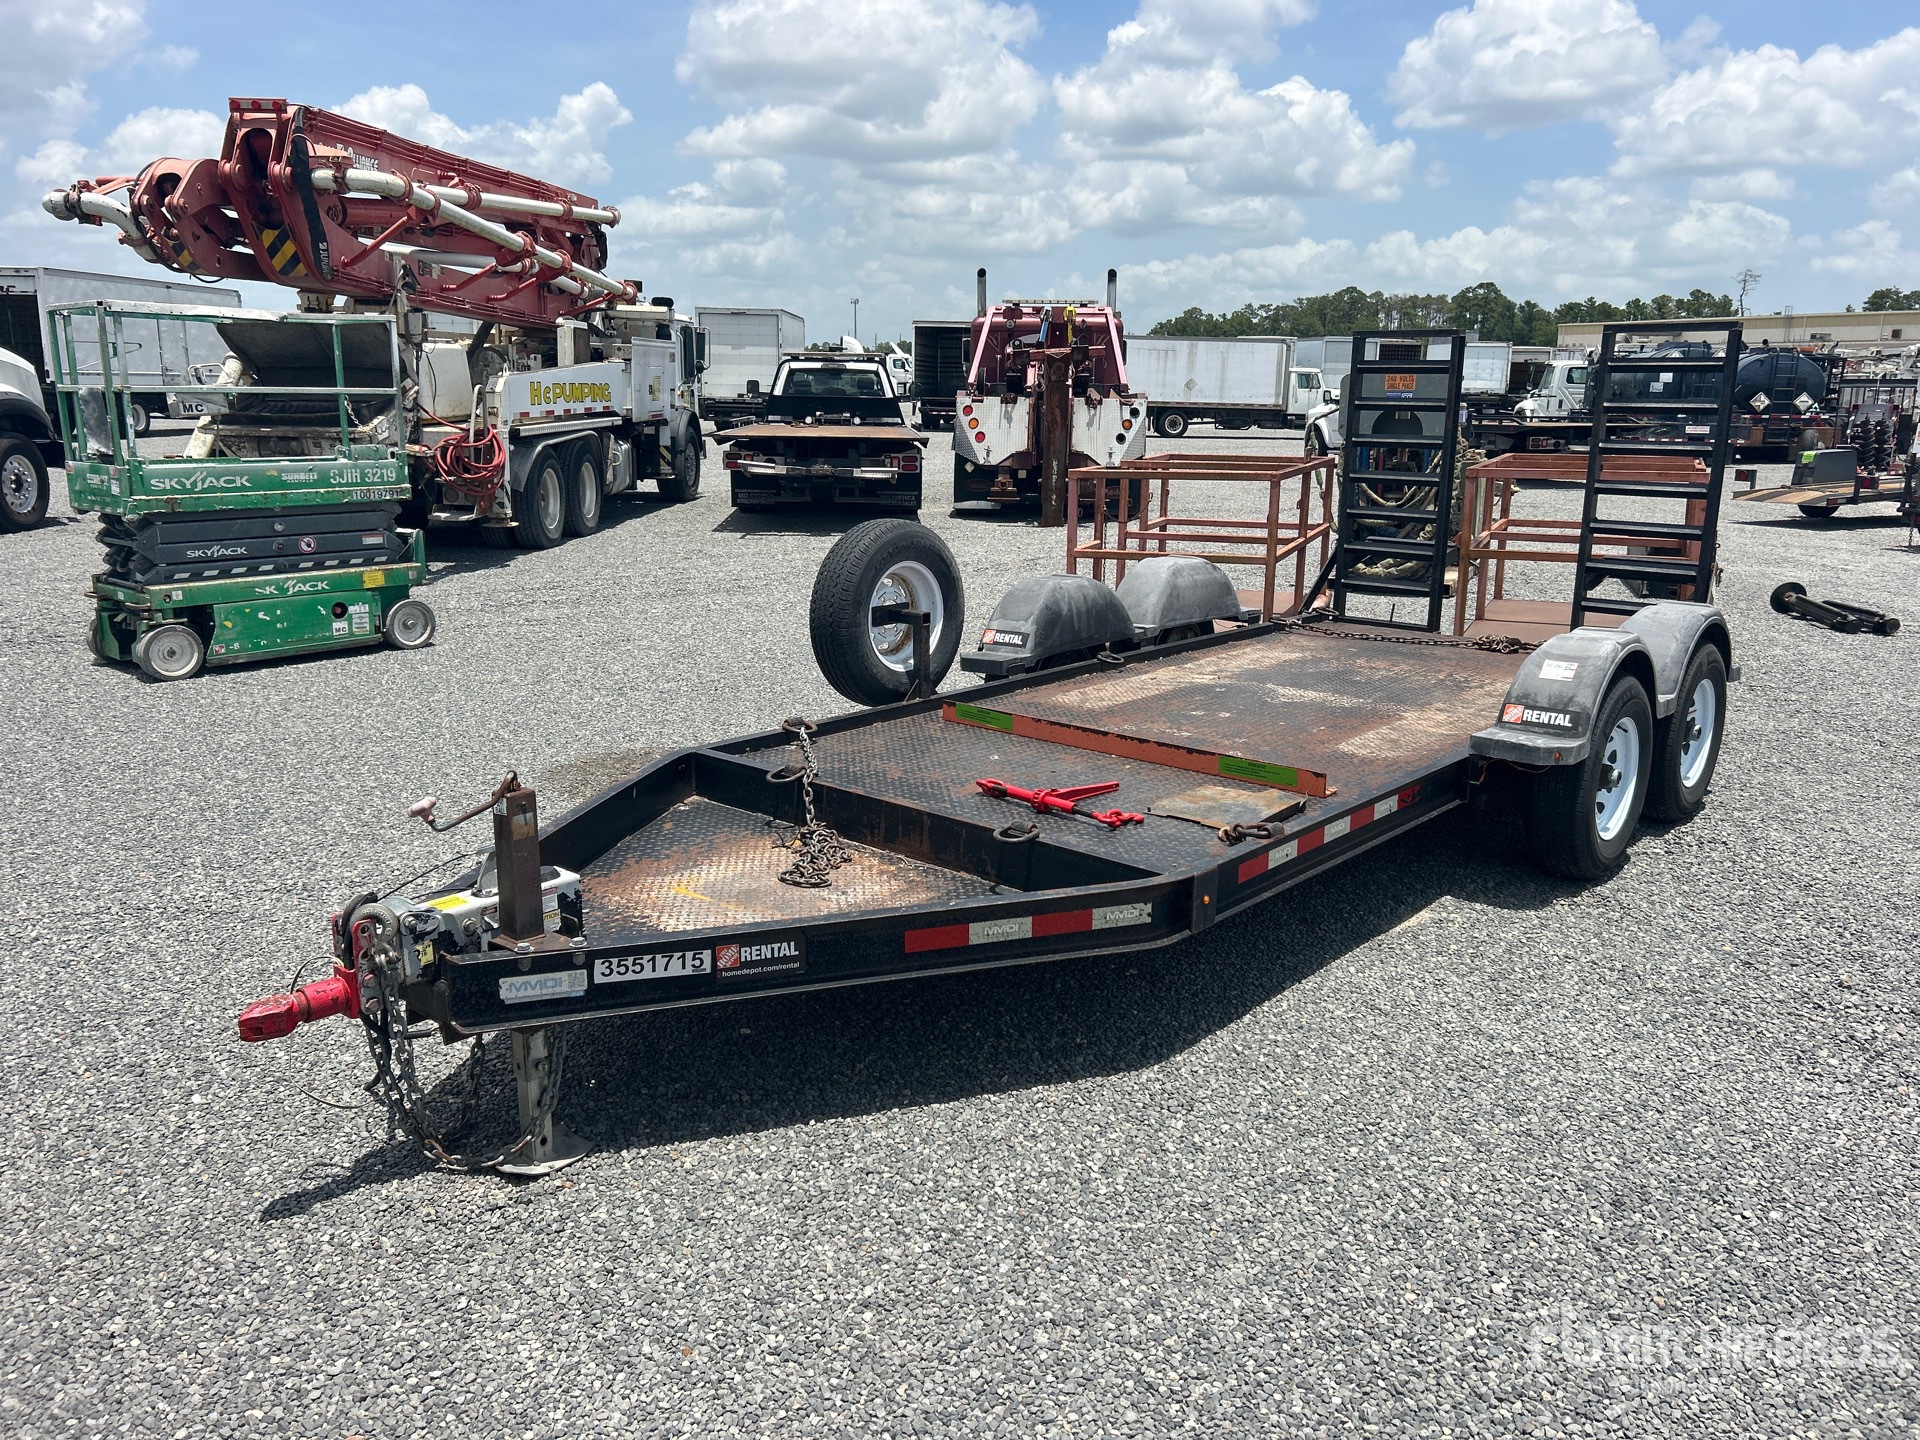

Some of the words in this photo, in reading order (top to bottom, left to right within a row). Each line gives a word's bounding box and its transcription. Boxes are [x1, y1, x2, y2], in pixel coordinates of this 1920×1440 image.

[181, 401, 204, 413] MC
[150, 470, 252, 492] SKYJACK
[281, 472, 318, 480] SUNBELT
[364, 467, 396, 482] 3219
[186, 544, 248, 558] SKYJACK
[994, 632, 1023, 645] RENTAL
[1522, 709, 1573, 727] RENTAL
[1106, 908, 1140, 921] MMDI
[984, 923, 1019, 935] MMDI
[717, 944, 739, 968] HOME
[740, 941, 800, 962] RENTAL
[600, 951, 705, 977] 3551715
[722, 961, 800, 978] homedepot.com/rental
